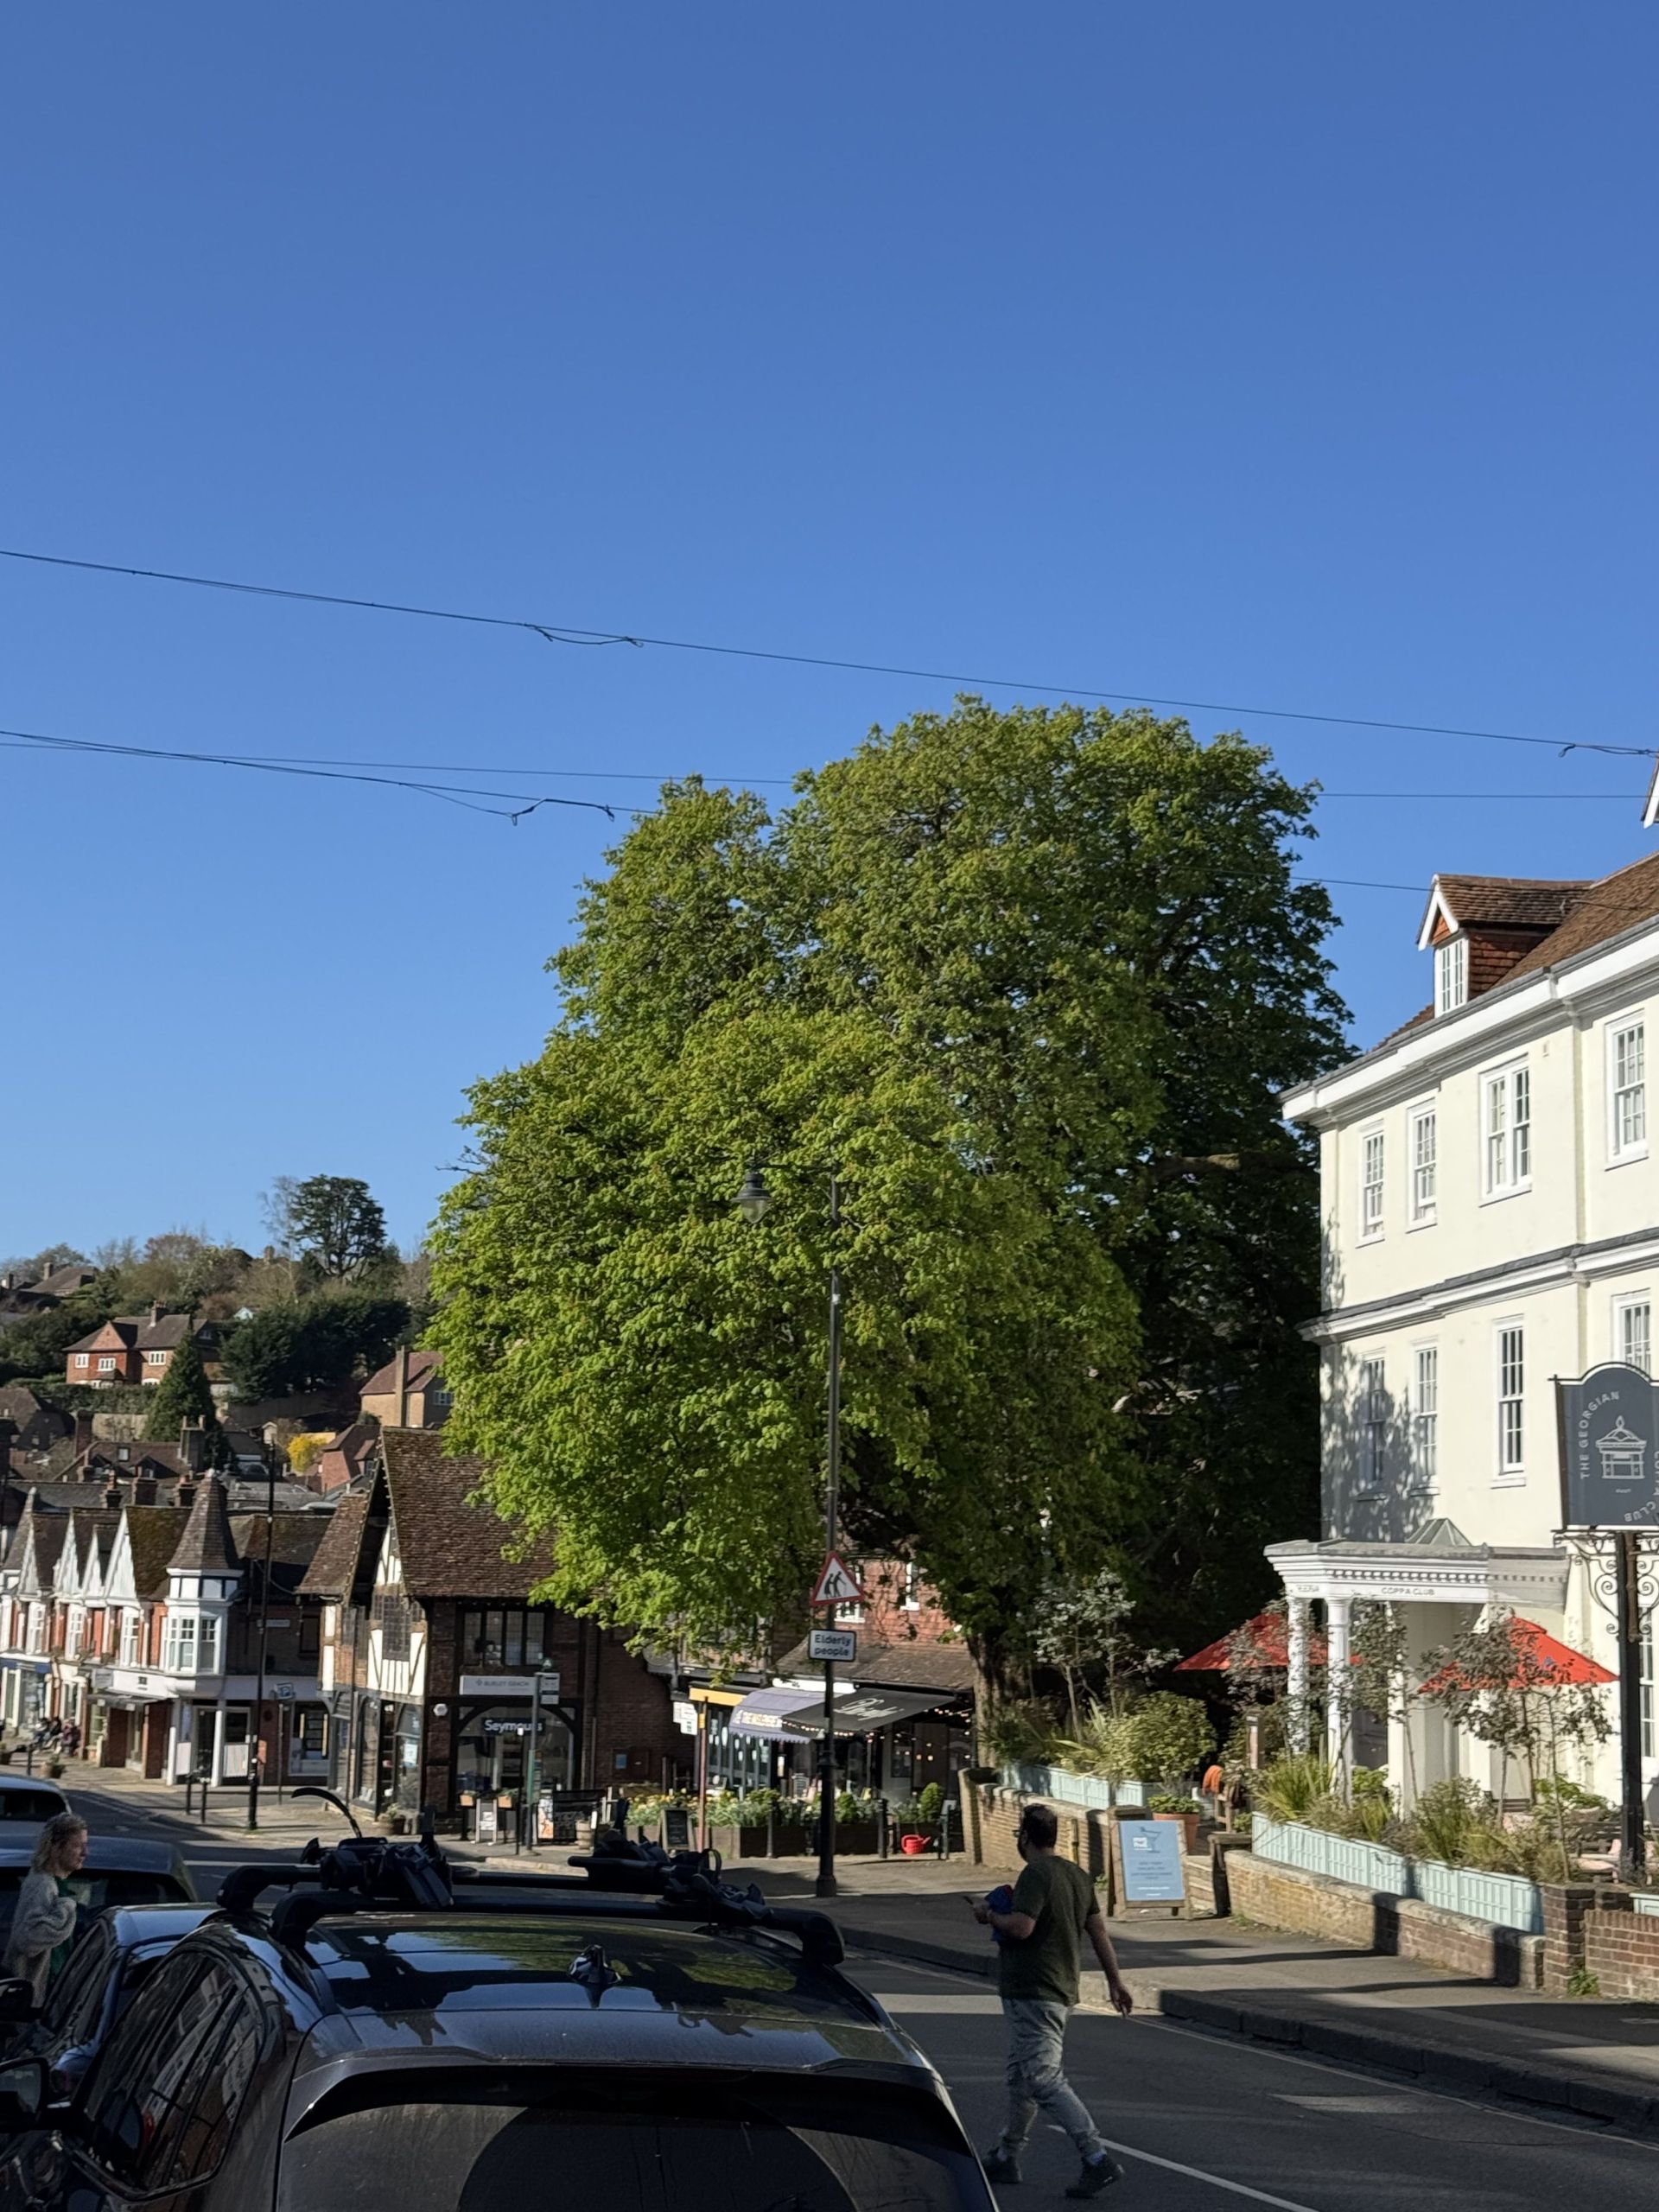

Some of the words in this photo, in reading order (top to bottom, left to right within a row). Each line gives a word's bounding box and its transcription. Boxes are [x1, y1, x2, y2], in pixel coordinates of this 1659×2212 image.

[1579, 1391, 1620, 1448] GEORGIAN
[1580, 1454, 1590, 1479] THE
[1624, 1501, 1656, 1522] CLUB
[1413, 1587, 1434, 1596] CLUB
[815, 1634, 851, 1647] Elderly
[814, 1646, 849, 1657] people
[485, 1719, 543, 1733] Seymous
